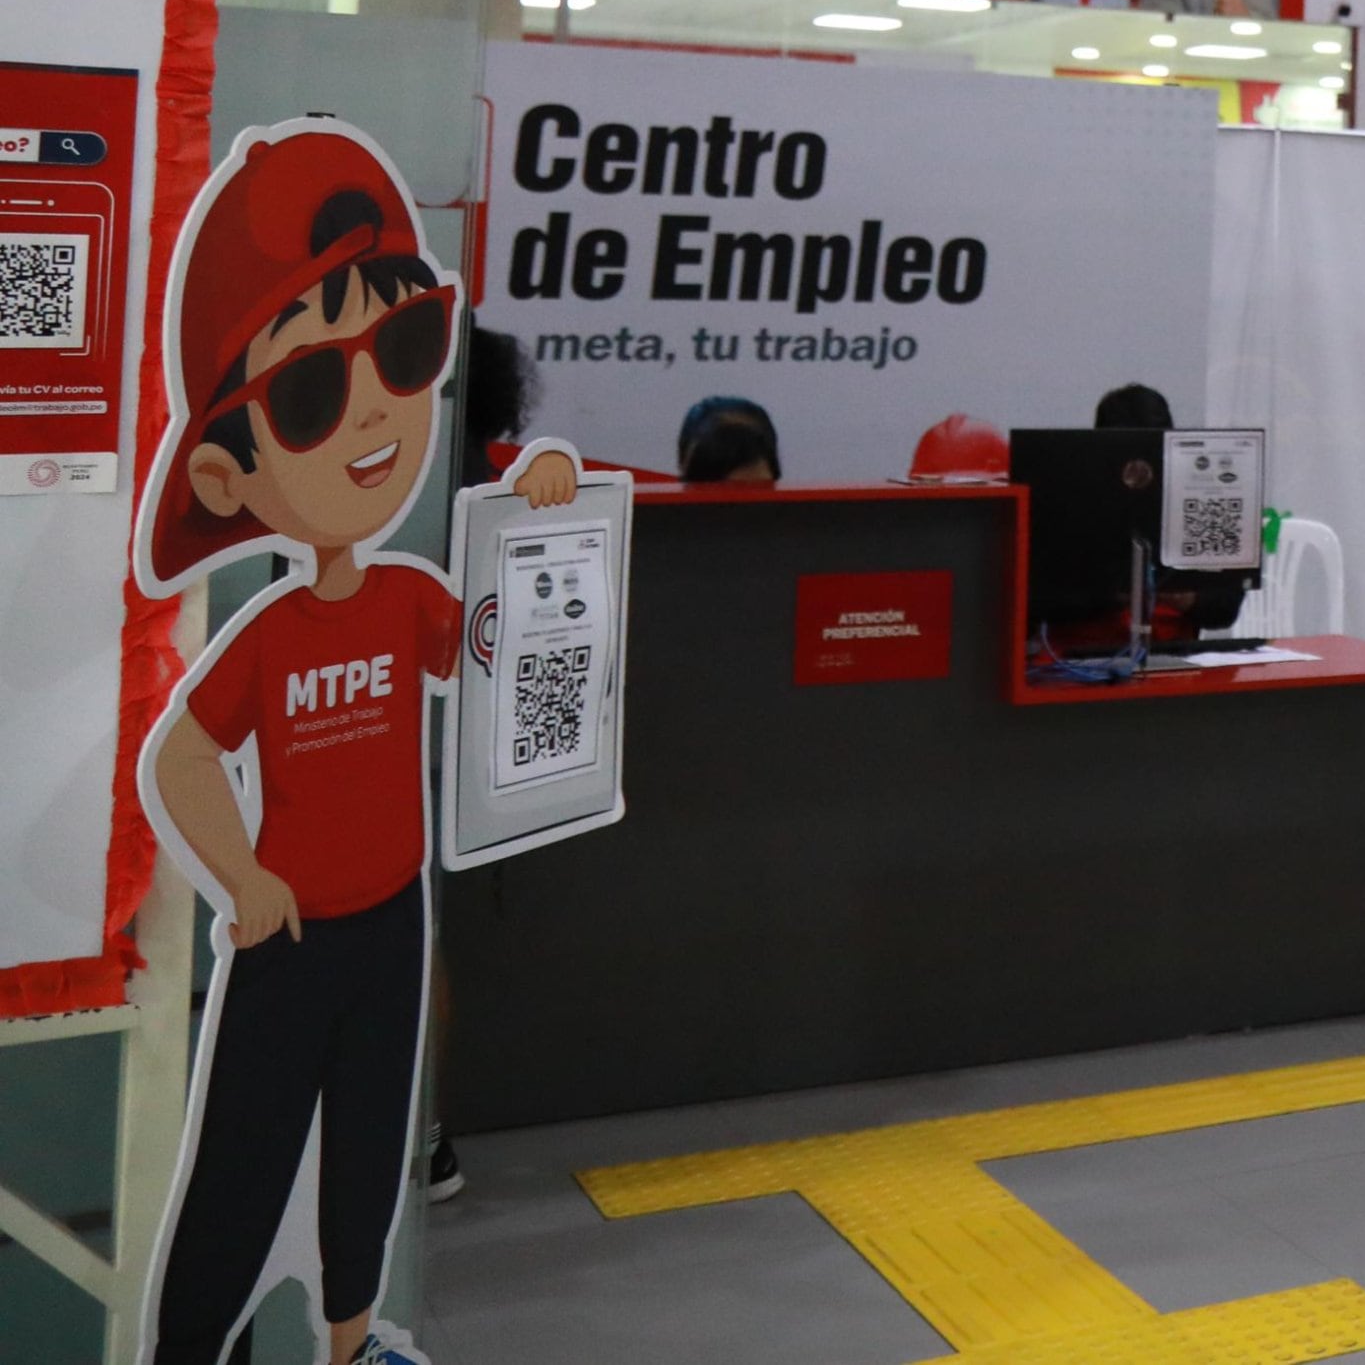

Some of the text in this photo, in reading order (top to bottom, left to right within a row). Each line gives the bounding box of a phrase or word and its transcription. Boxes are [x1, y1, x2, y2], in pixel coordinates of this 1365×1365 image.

[513, 103, 827, 201] Centro
[508, 211, 987, 314] de Empleo
[535, 327, 919, 370] meta, tu trabajo
[18, 385, 31, 394] tu
[33, 385, 51, 394] CV
[52, 385, 63, 394] al
[64, 386, 104, 394] correo
[838, 608, 906, 625] ATENCIÓN
[822, 625, 921, 642] PREFERENCIAL
[285, 653, 394, 718] MTPE
[294, 706, 384, 733] Ministerio de Trabajo
[292, 733, 342, 753] Promoción
[357, 722, 391, 739] Empleo
